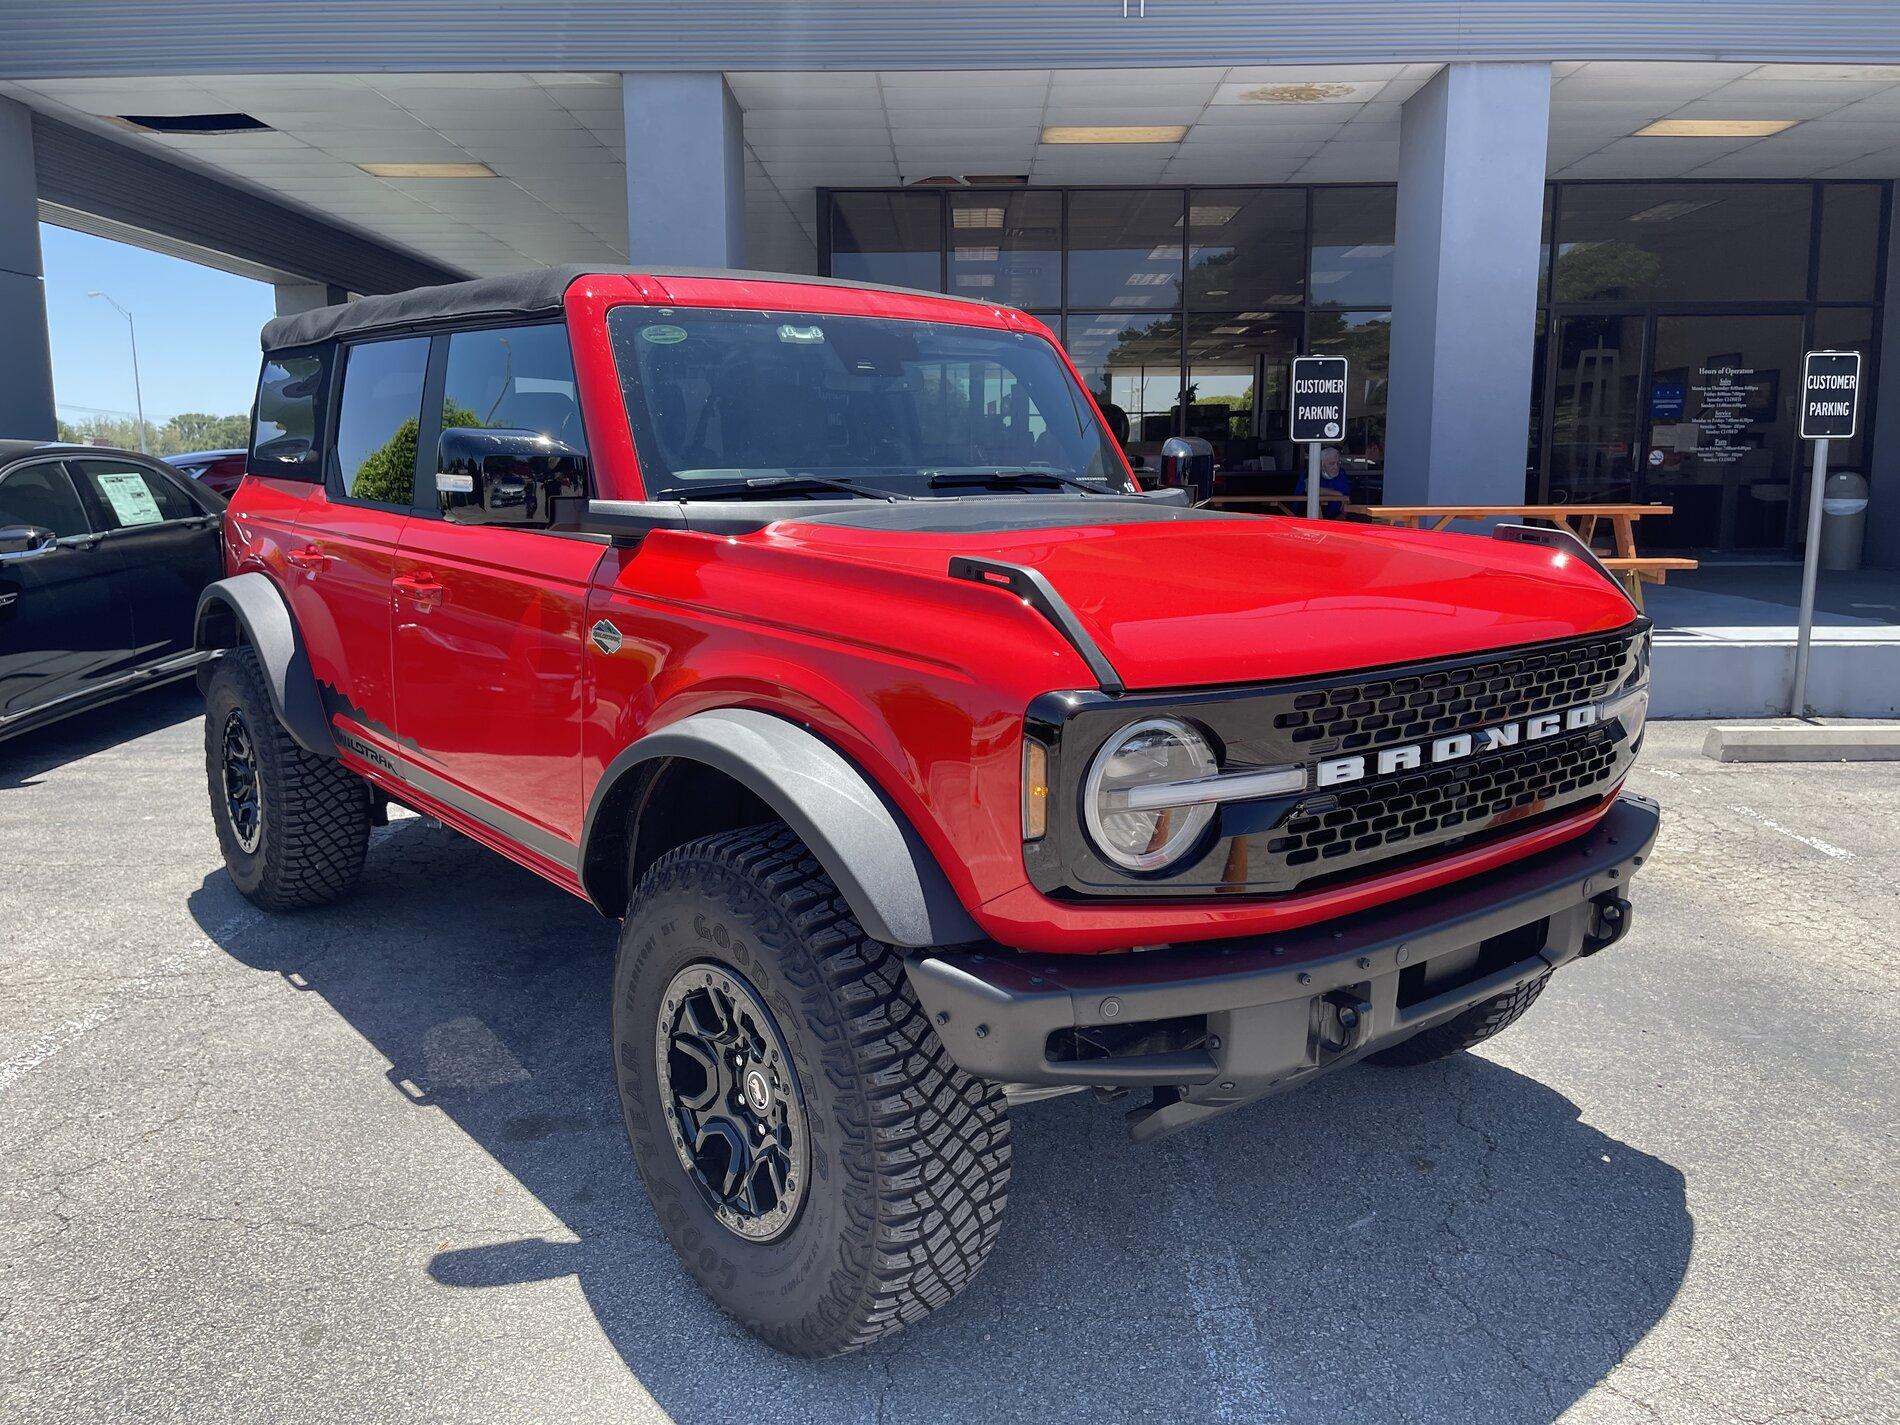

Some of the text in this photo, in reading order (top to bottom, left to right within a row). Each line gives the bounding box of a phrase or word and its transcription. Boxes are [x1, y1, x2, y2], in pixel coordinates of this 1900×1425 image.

[1699, 367, 1717, 375] Hours
[1725, 367, 1754, 376] Operation
[1296, 379, 1344, 394] CUSTOMER
[1807, 375, 1856, 390] CUSTOMER
[1298, 406, 1339, 420] PARKING
[1809, 402, 1849, 416] PARKING
[1317, 705, 1596, 787] BRONCO
